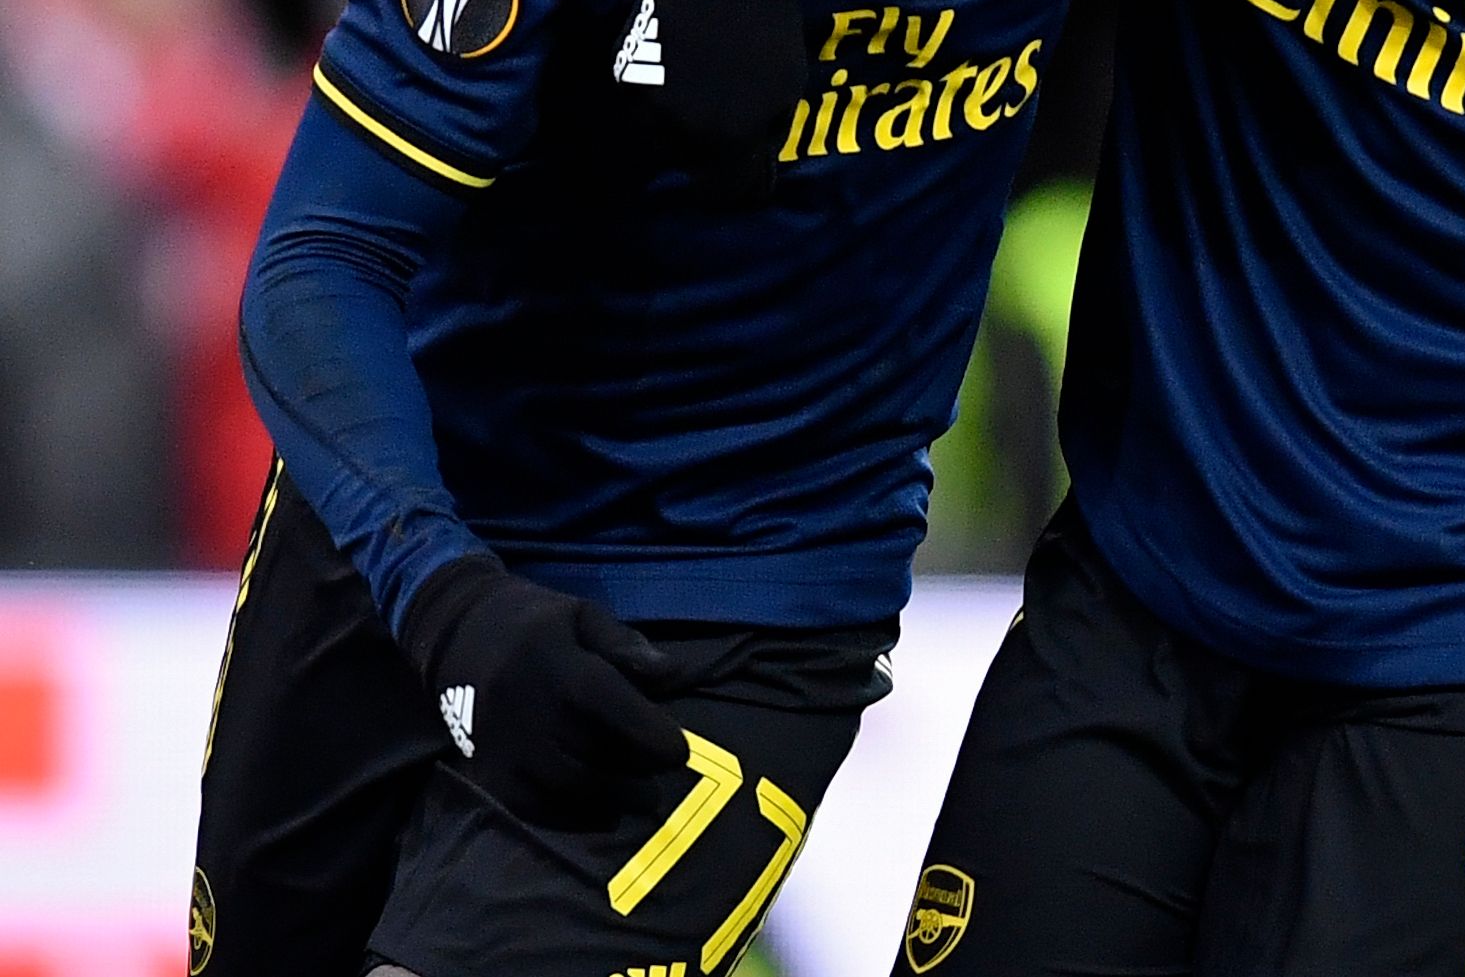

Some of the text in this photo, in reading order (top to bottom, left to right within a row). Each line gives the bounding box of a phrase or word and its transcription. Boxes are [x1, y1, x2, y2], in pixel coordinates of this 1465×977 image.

[819, 6, 955, 68] Fly
[778, 38, 1042, 162] irates
[608, 728, 806, 975] 77
